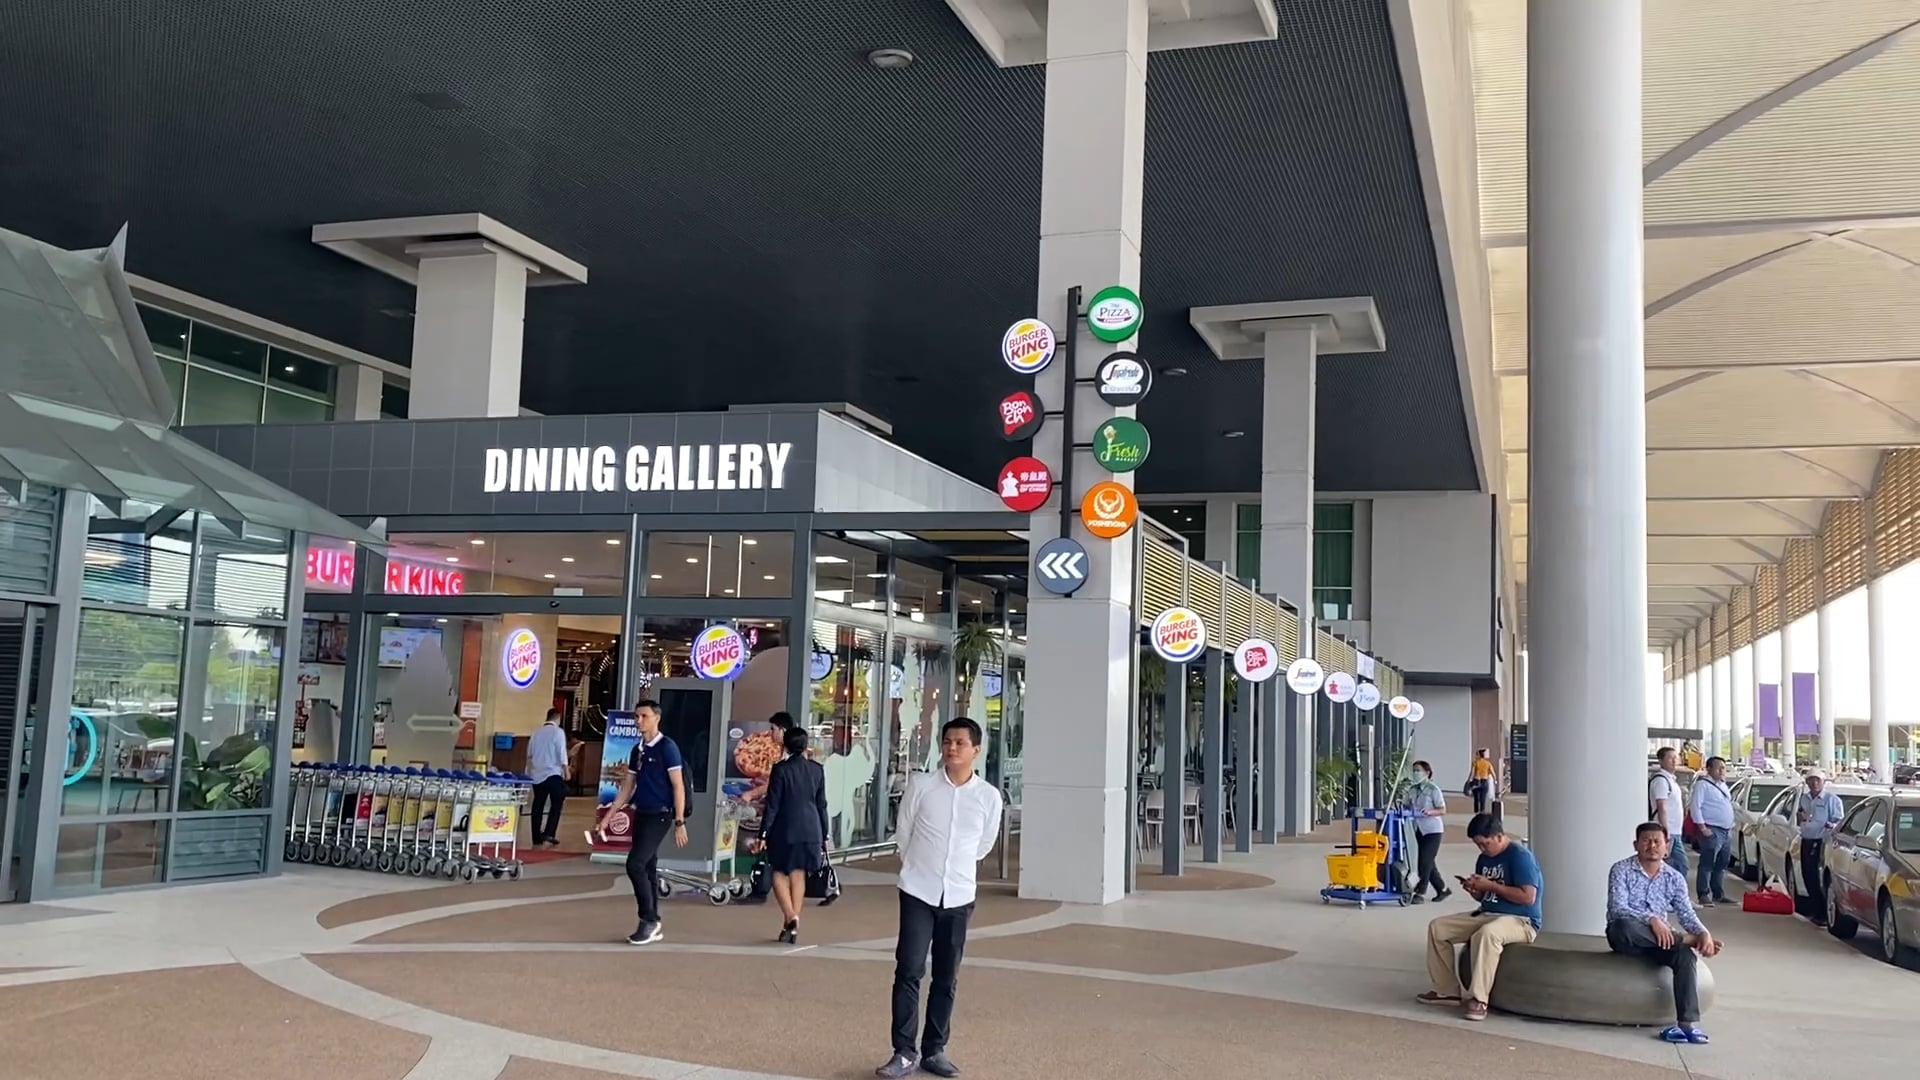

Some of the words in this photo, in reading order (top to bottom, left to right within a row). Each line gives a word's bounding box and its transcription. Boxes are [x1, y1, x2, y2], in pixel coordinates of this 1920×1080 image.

[1009, 328, 1047, 349] BURGER
[1011, 337, 1049, 361] KING
[484, 446, 617, 493] DINING
[624, 443, 793, 492] GALLERY
[305, 547, 403, 592] BURR
[404, 564, 464, 595] KING
[1160, 619, 1197, 635] BURGER
[1161, 628, 1198, 647] KING
[699, 635, 737, 655] BURGER
[511, 651, 537, 673] KING
[700, 645, 739, 669] KING
